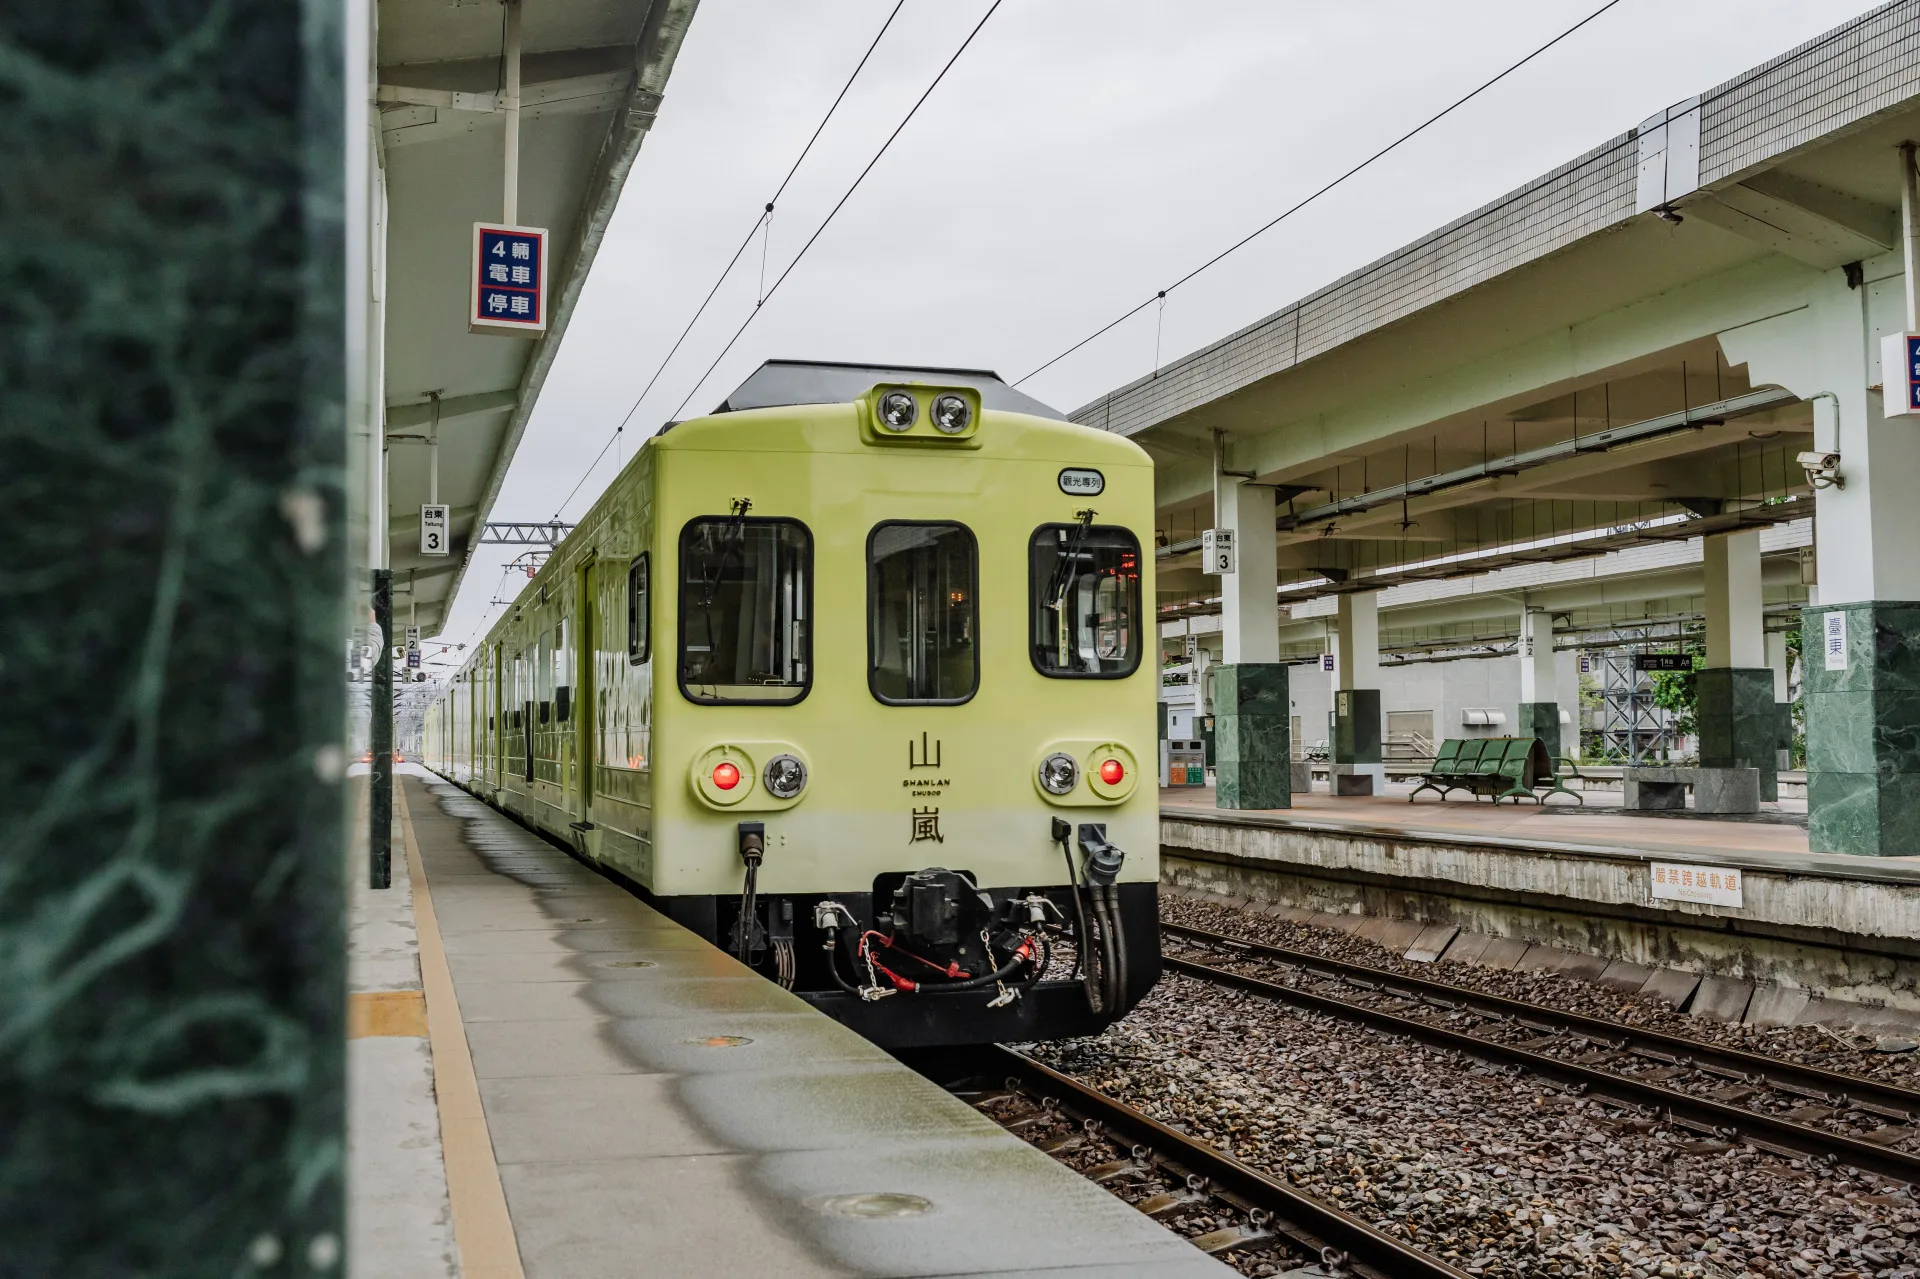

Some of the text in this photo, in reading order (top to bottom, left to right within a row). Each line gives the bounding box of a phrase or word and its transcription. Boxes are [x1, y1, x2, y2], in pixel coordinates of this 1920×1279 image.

[489, 264, 530, 284] 電車
[488, 293, 530, 315] 停車
[424, 510, 443, 519] 台東
[428, 533, 440, 550] 3
[1216, 534, 1231, 542] 台東
[1220, 555, 1228, 569] 3
[409, 640, 416, 650] 2
[1188, 647, 1194, 656] 2
[1527, 647, 1533, 656] 2
[909, 732, 941, 770] 山
[903, 779, 950, 787] SHANLAN
[909, 806, 944, 845] 嵐
[1655, 867, 1737, 891] 嚴禁跨越軌道
